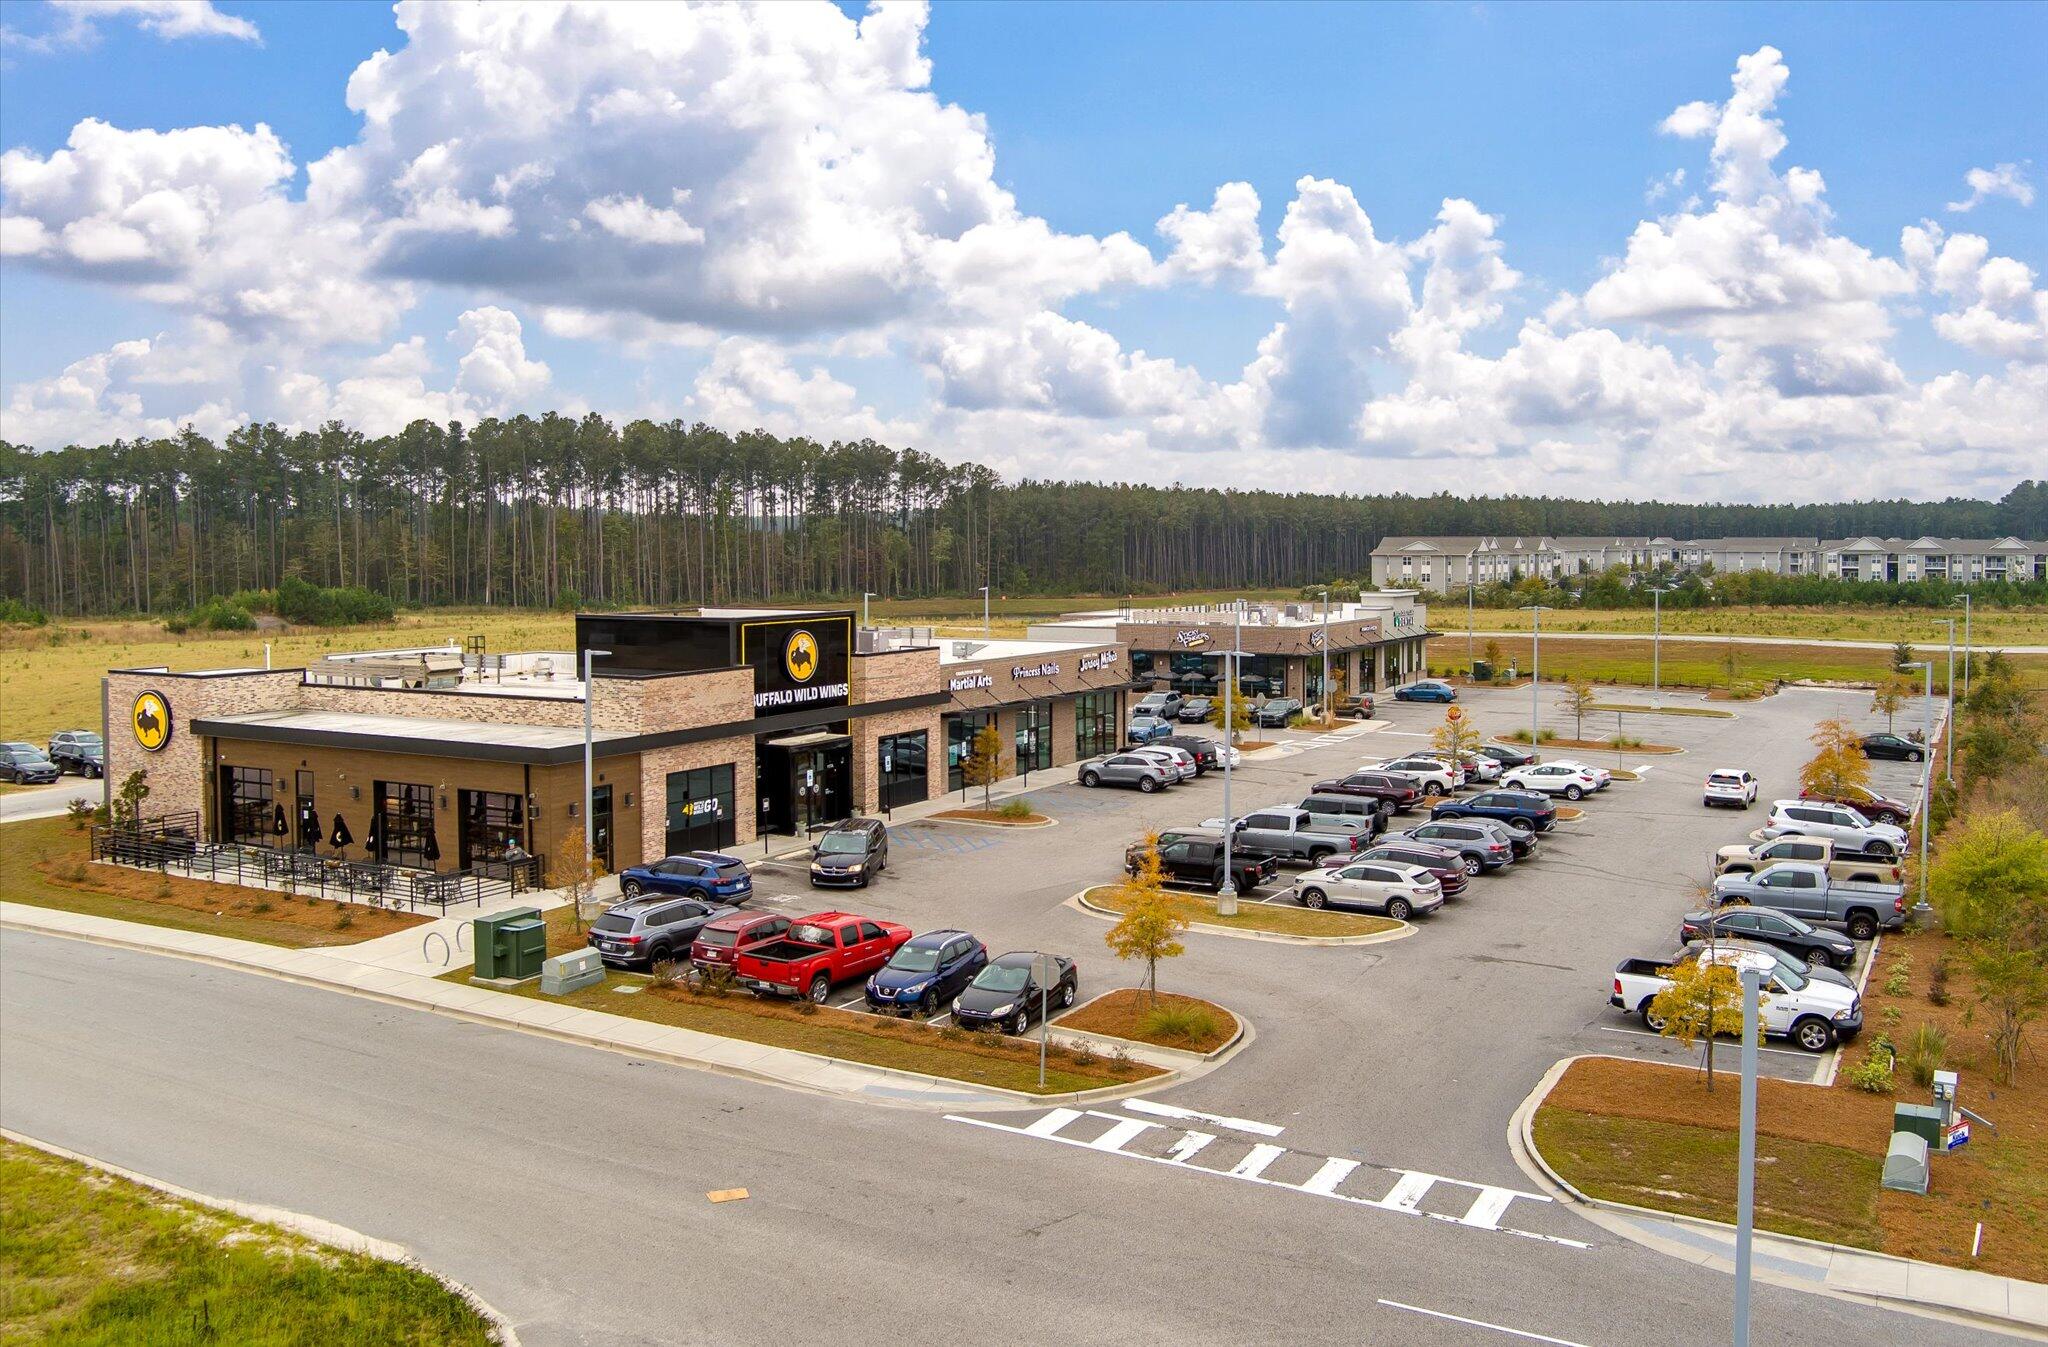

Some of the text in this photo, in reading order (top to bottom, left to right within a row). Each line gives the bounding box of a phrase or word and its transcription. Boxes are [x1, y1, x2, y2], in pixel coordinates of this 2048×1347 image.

[1013, 662, 1060, 681] Princess Nails
[1080, 658, 1100, 672] Jersey
[950, 674, 993, 691] Martial Arts
[793, 686, 818, 702] WILD
[819, 683, 849, 699] WINGS
[704, 797, 719, 813] GO
